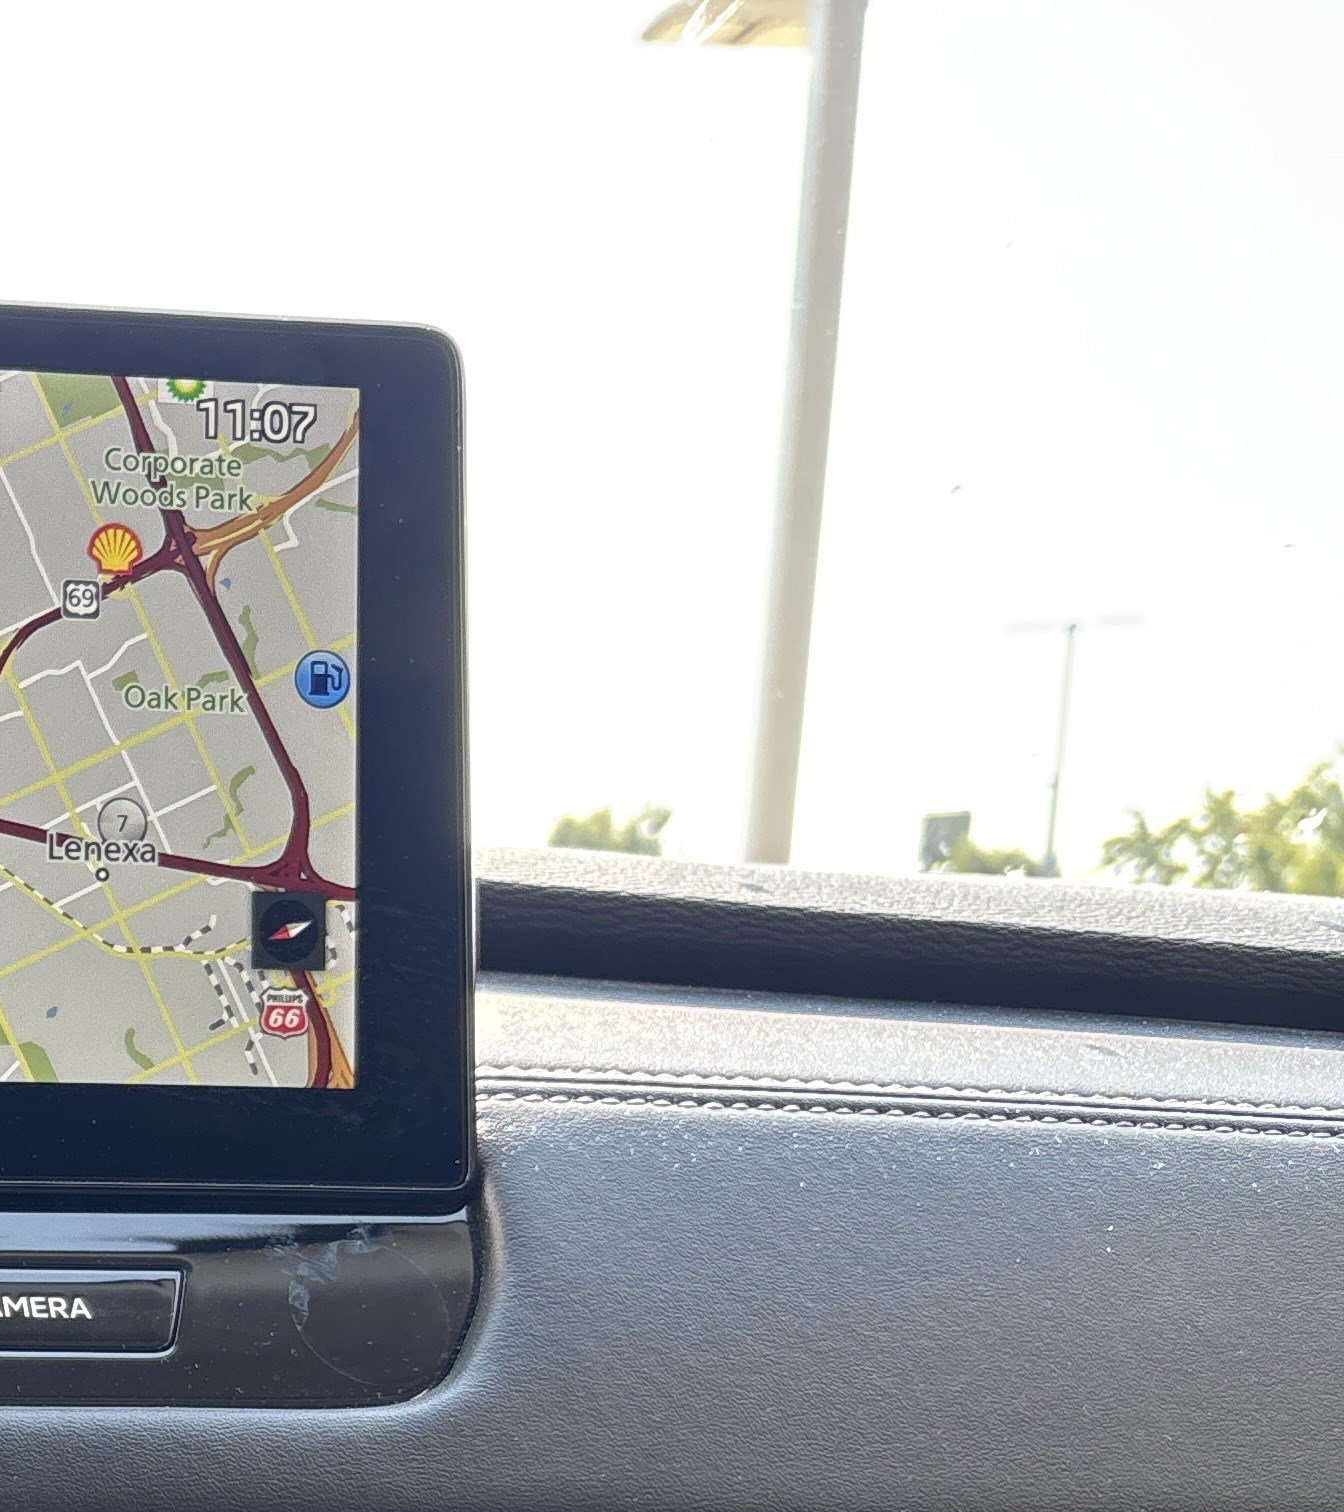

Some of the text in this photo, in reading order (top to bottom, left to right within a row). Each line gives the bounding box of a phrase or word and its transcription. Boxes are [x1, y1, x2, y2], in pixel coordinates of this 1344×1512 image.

[196, 399, 317, 443] 11:07
[105, 447, 241, 484] Corporate
[91, 480, 254, 511] Woods Park
[69, 589, 94, 608] 69
[125, 685, 244, 712] Oak Park
[117, 815, 128, 831] 7
[48, 834, 156, 863] Lenexa
[269, 1008, 301, 1029] 66
